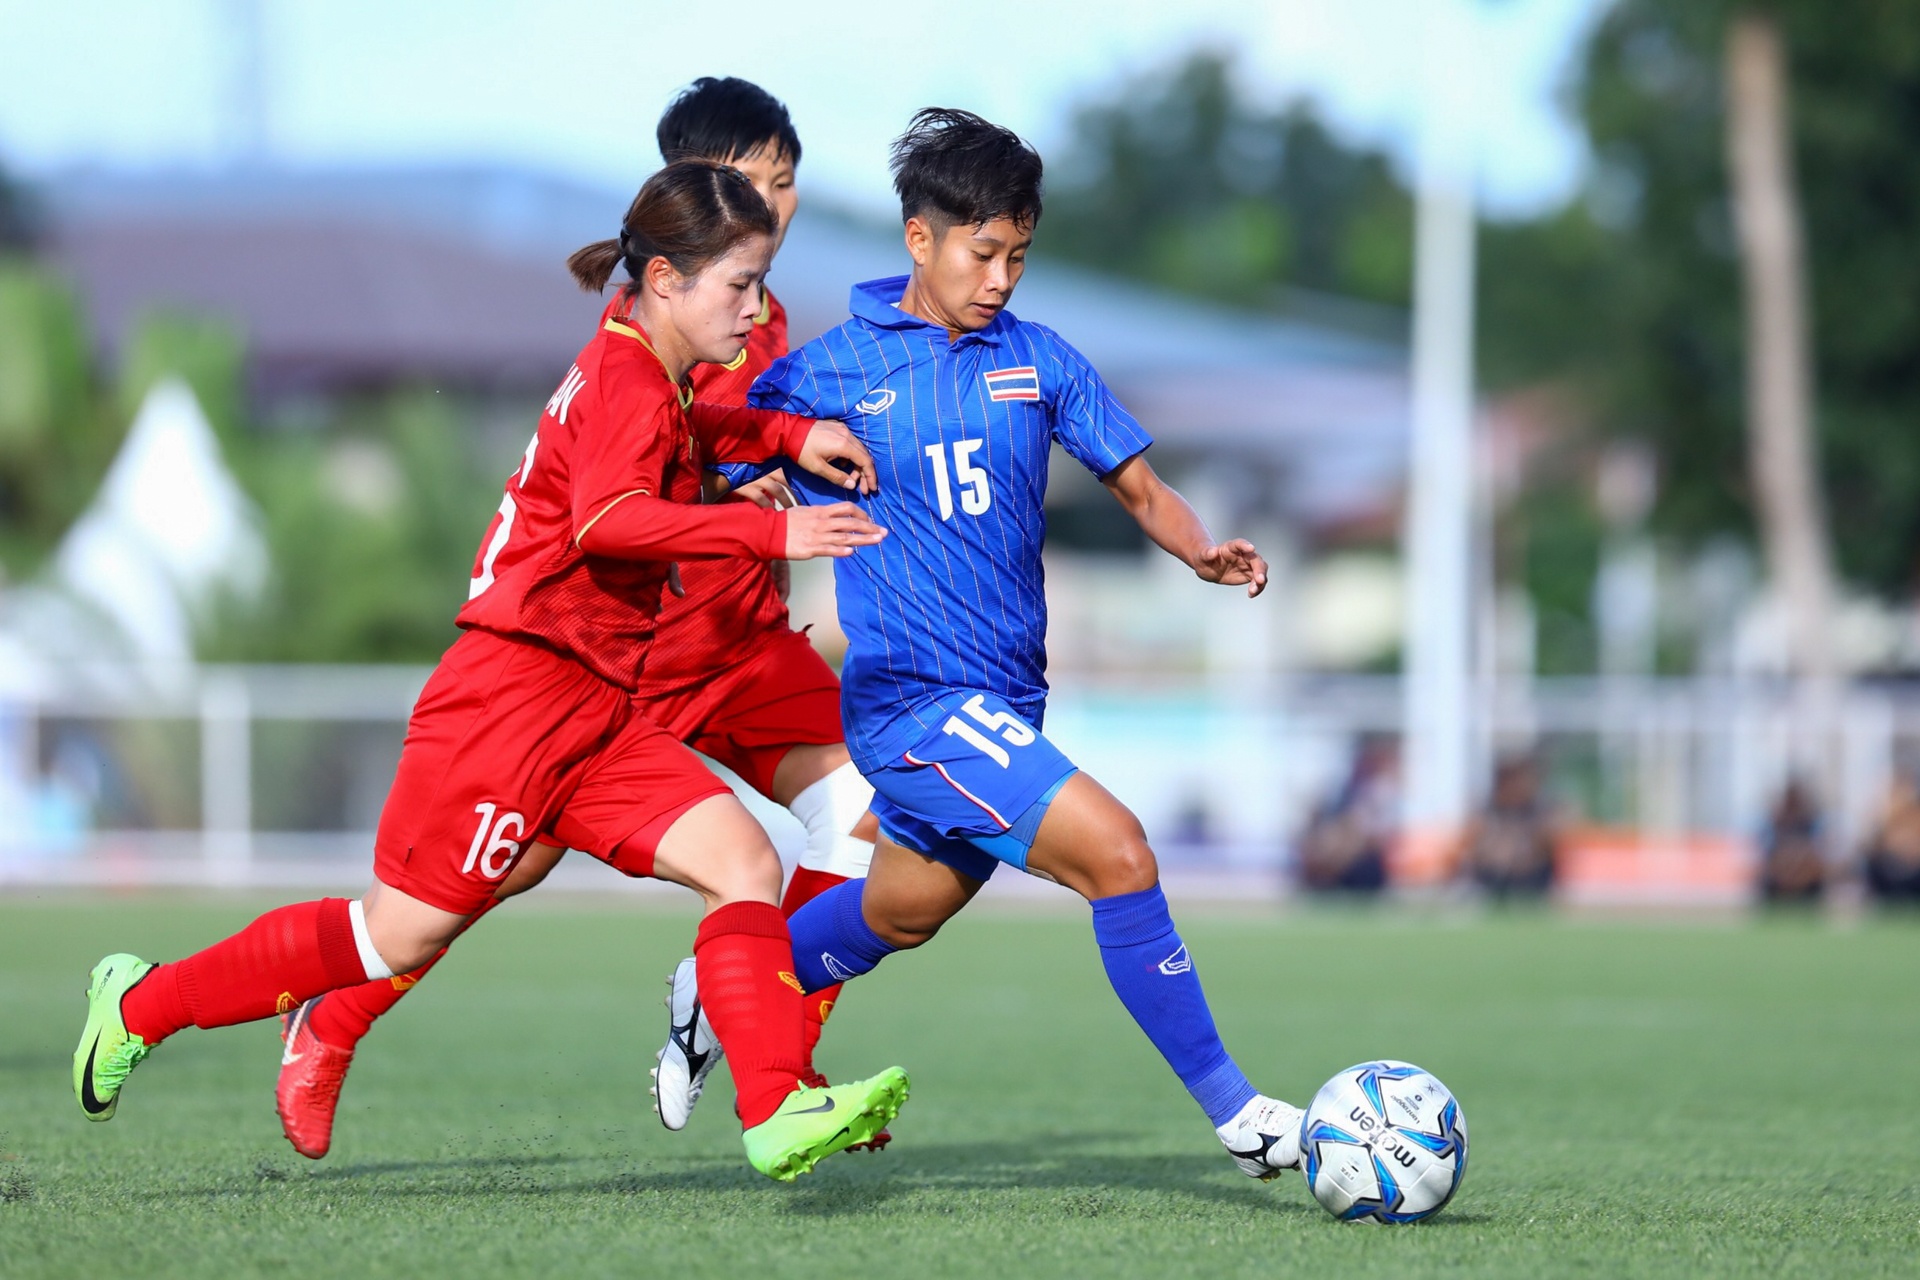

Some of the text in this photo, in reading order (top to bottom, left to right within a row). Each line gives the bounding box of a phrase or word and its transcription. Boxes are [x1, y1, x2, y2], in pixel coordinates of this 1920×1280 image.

[545, 362, 587, 425] AN
[924, 438, 991, 522] 15
[942, 693, 1036, 770] 15
[461, 801, 525, 879] 16
[1349, 1105, 1417, 1168] molten
